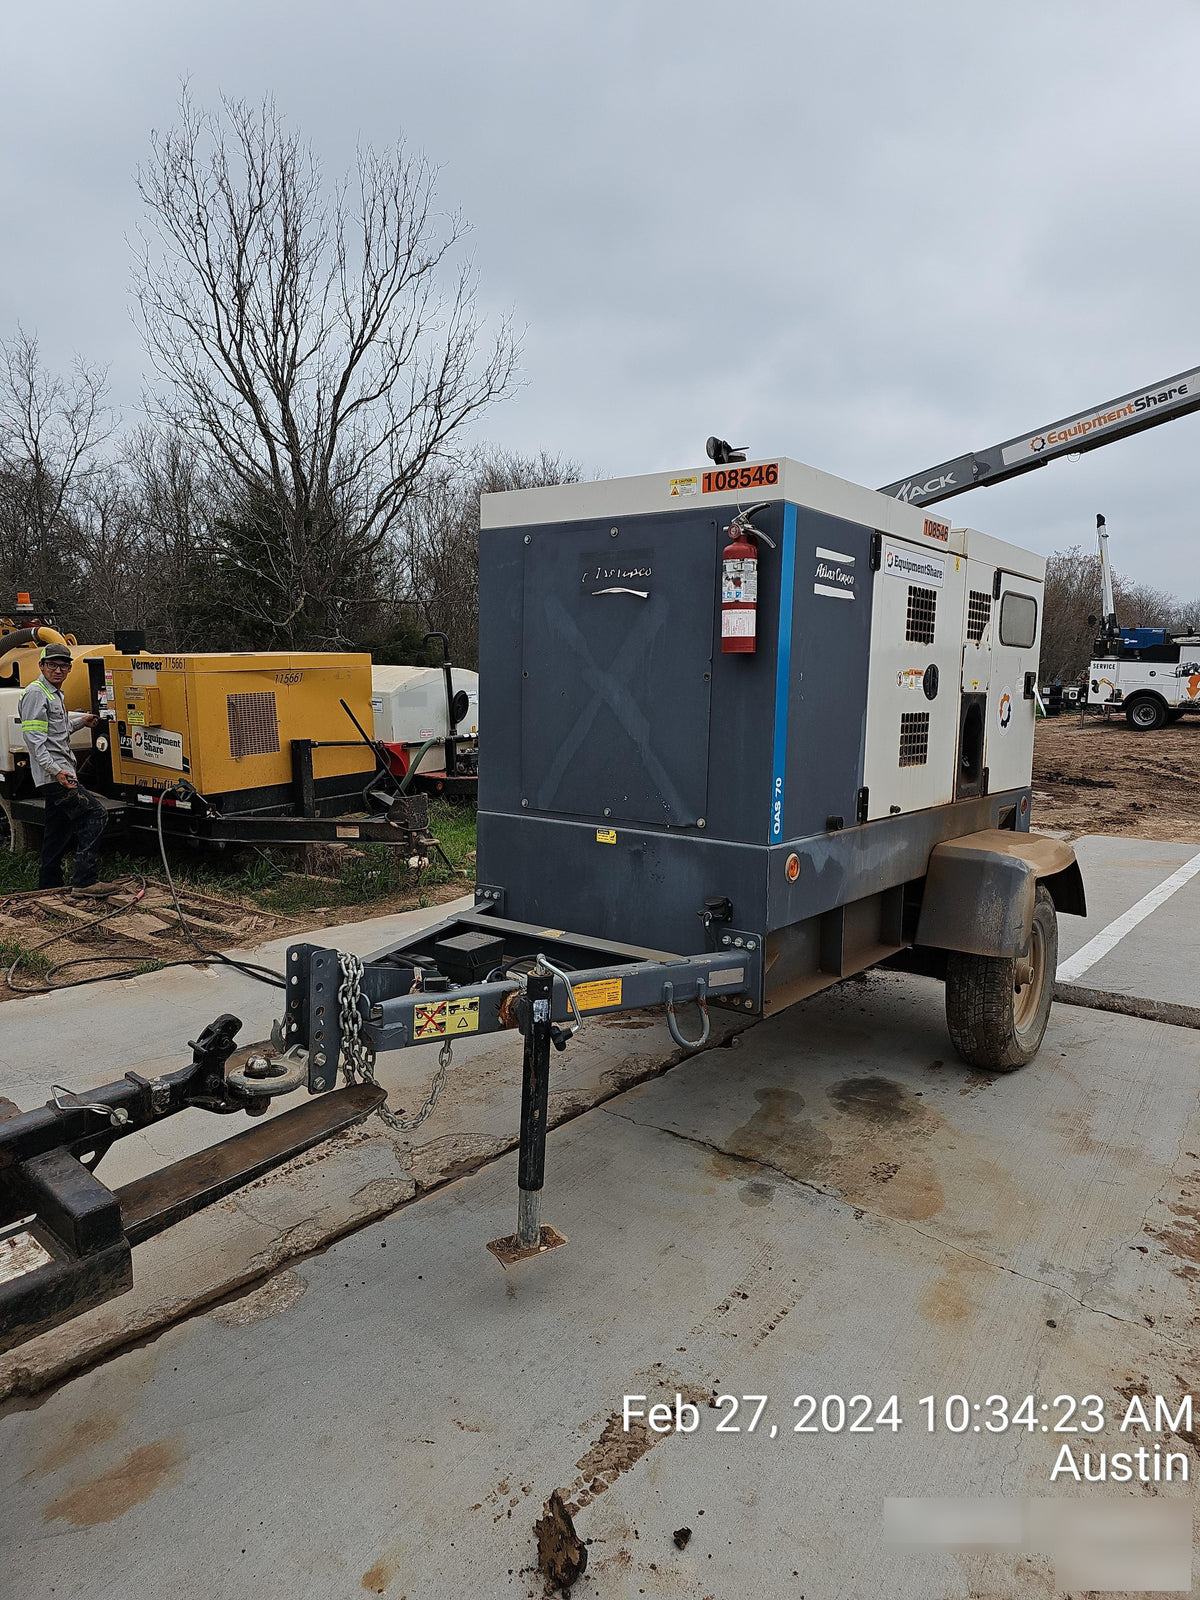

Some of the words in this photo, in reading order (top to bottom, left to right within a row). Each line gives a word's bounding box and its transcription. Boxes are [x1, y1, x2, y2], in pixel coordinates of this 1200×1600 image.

[1046, 384, 1188, 445] EquipmentShare
[704, 464, 778, 491] 108546
[924, 520, 949, 541] 108546
[815, 563, 836, 580] Atlas
[836, 567, 855, 586] Copco
[894, 555, 943, 579] EquipmentShare
[131, 658, 162, 671] Vermeer
[165, 657, 186, 669] 115661
[275, 672, 304, 684] 115661
[143, 732, 181, 748] Equipment
[143, 742, 164, 754] Share
[775, 777, 782, 798] 70
